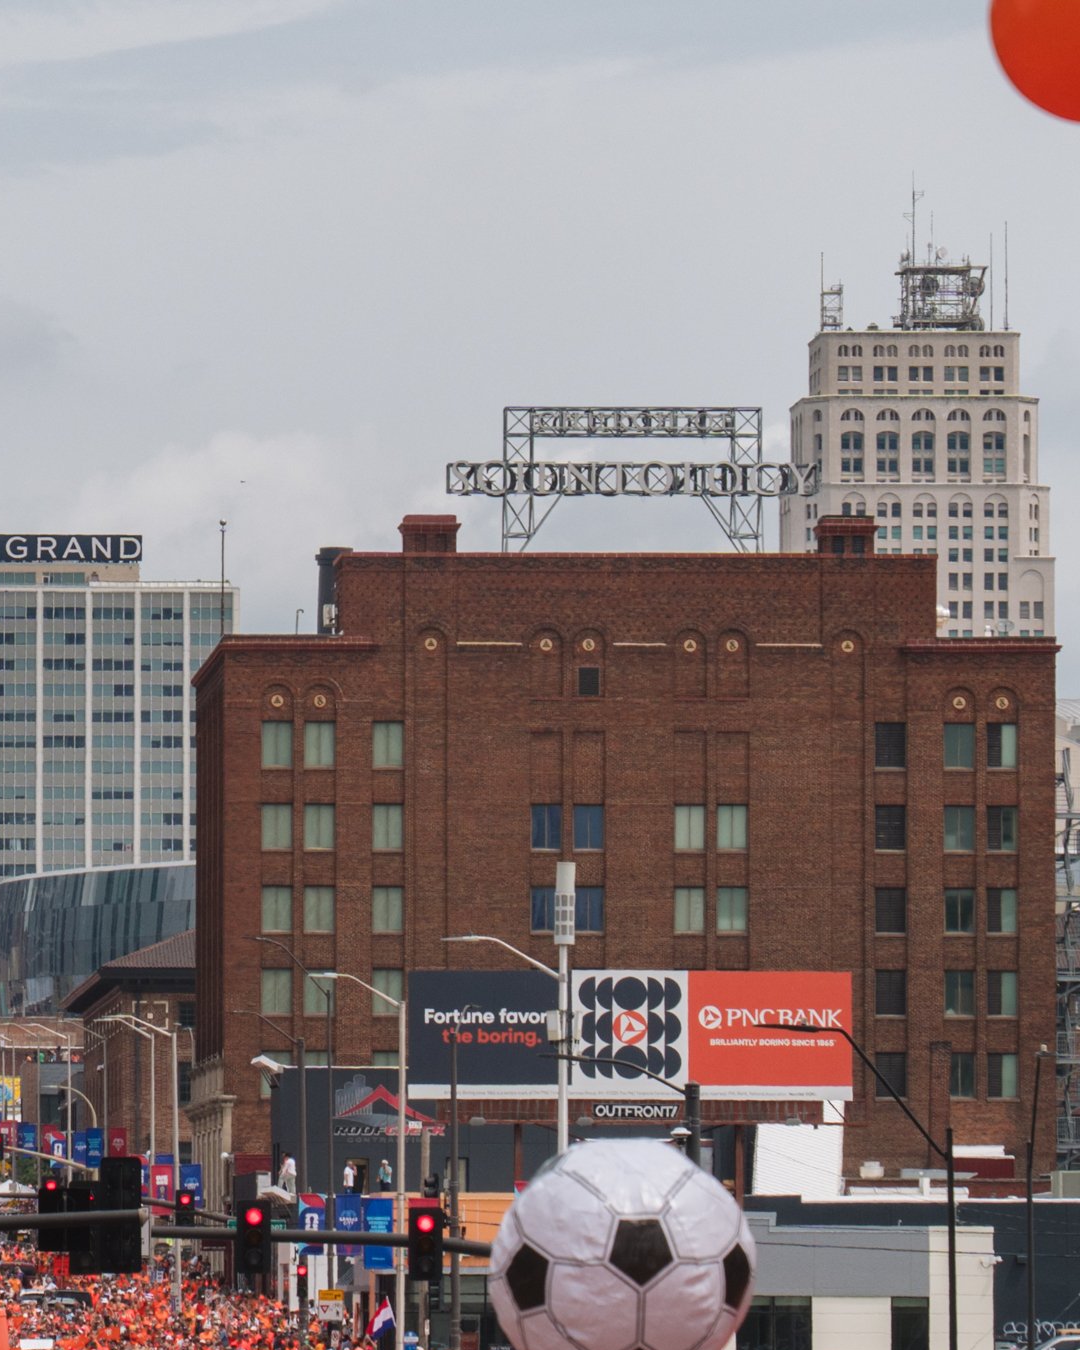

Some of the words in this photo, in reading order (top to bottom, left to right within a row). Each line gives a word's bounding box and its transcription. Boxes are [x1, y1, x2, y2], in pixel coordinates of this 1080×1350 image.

[5, 536, 142, 559] GRAND
[424, 1008, 495, 1024] Fortune
[500, 1008, 547, 1024] favor
[725, 1008, 774, 1027] PNC
[777, 1008, 842, 1027] BANK
[442, 1028, 472, 1043] the
[477, 1028, 541, 1047] boring.
[710, 1038, 757, 1046] BRILLIANTLY
[759, 1038, 790, 1046] BORING
[792, 1038, 815, 1046] SINCE
